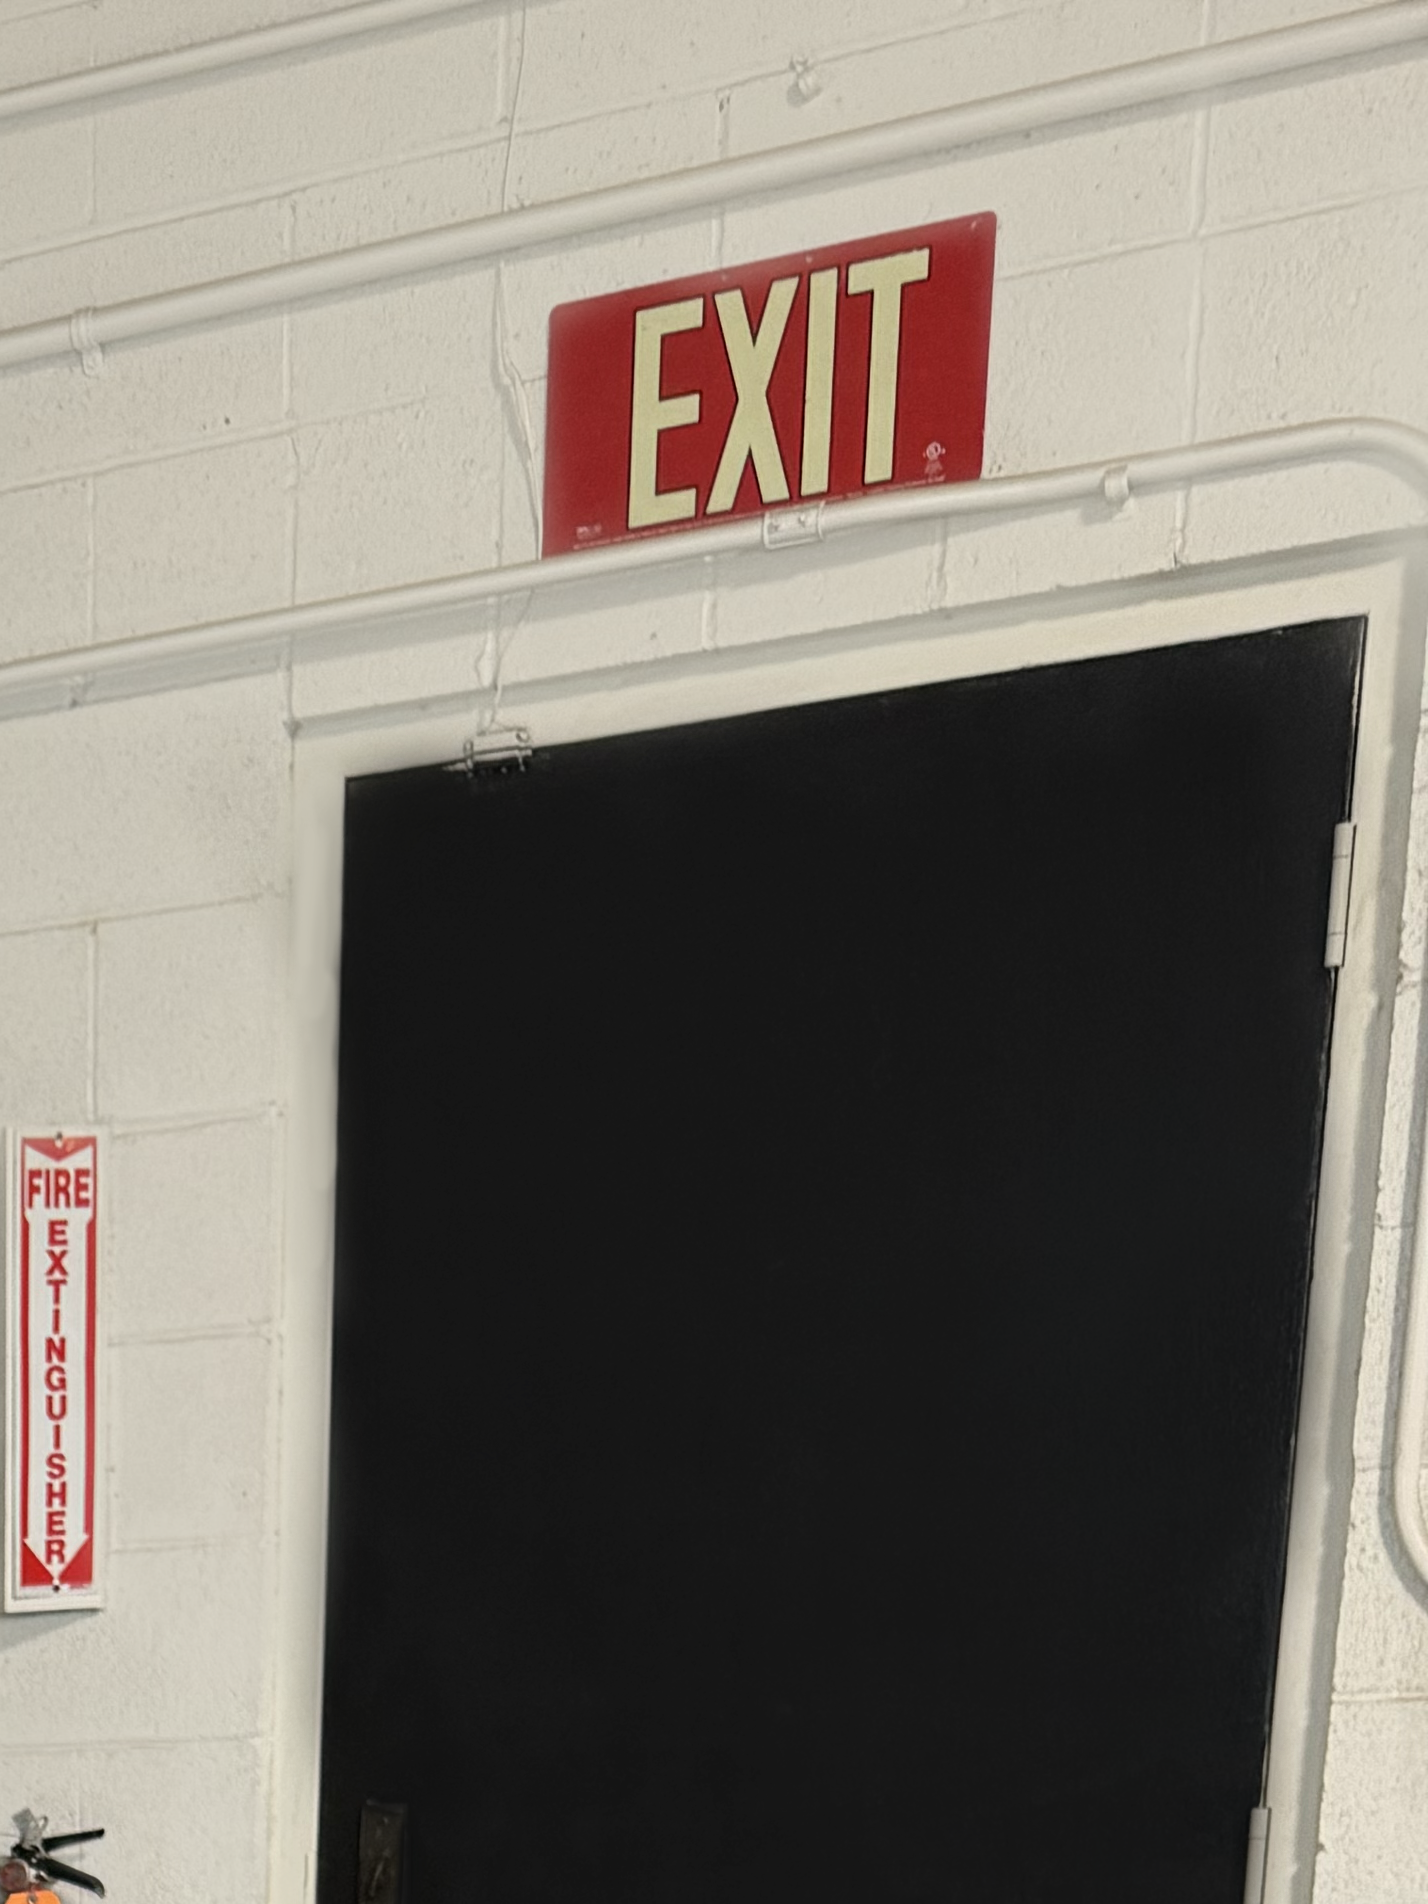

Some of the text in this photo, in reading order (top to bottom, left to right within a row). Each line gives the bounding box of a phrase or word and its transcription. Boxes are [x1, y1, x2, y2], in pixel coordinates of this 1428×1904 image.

[628, 246, 930, 529] EXIT
[28, 1169, 90, 1209] FIRE
[45, 1219, 68, 1564] EXTINGUISHER
